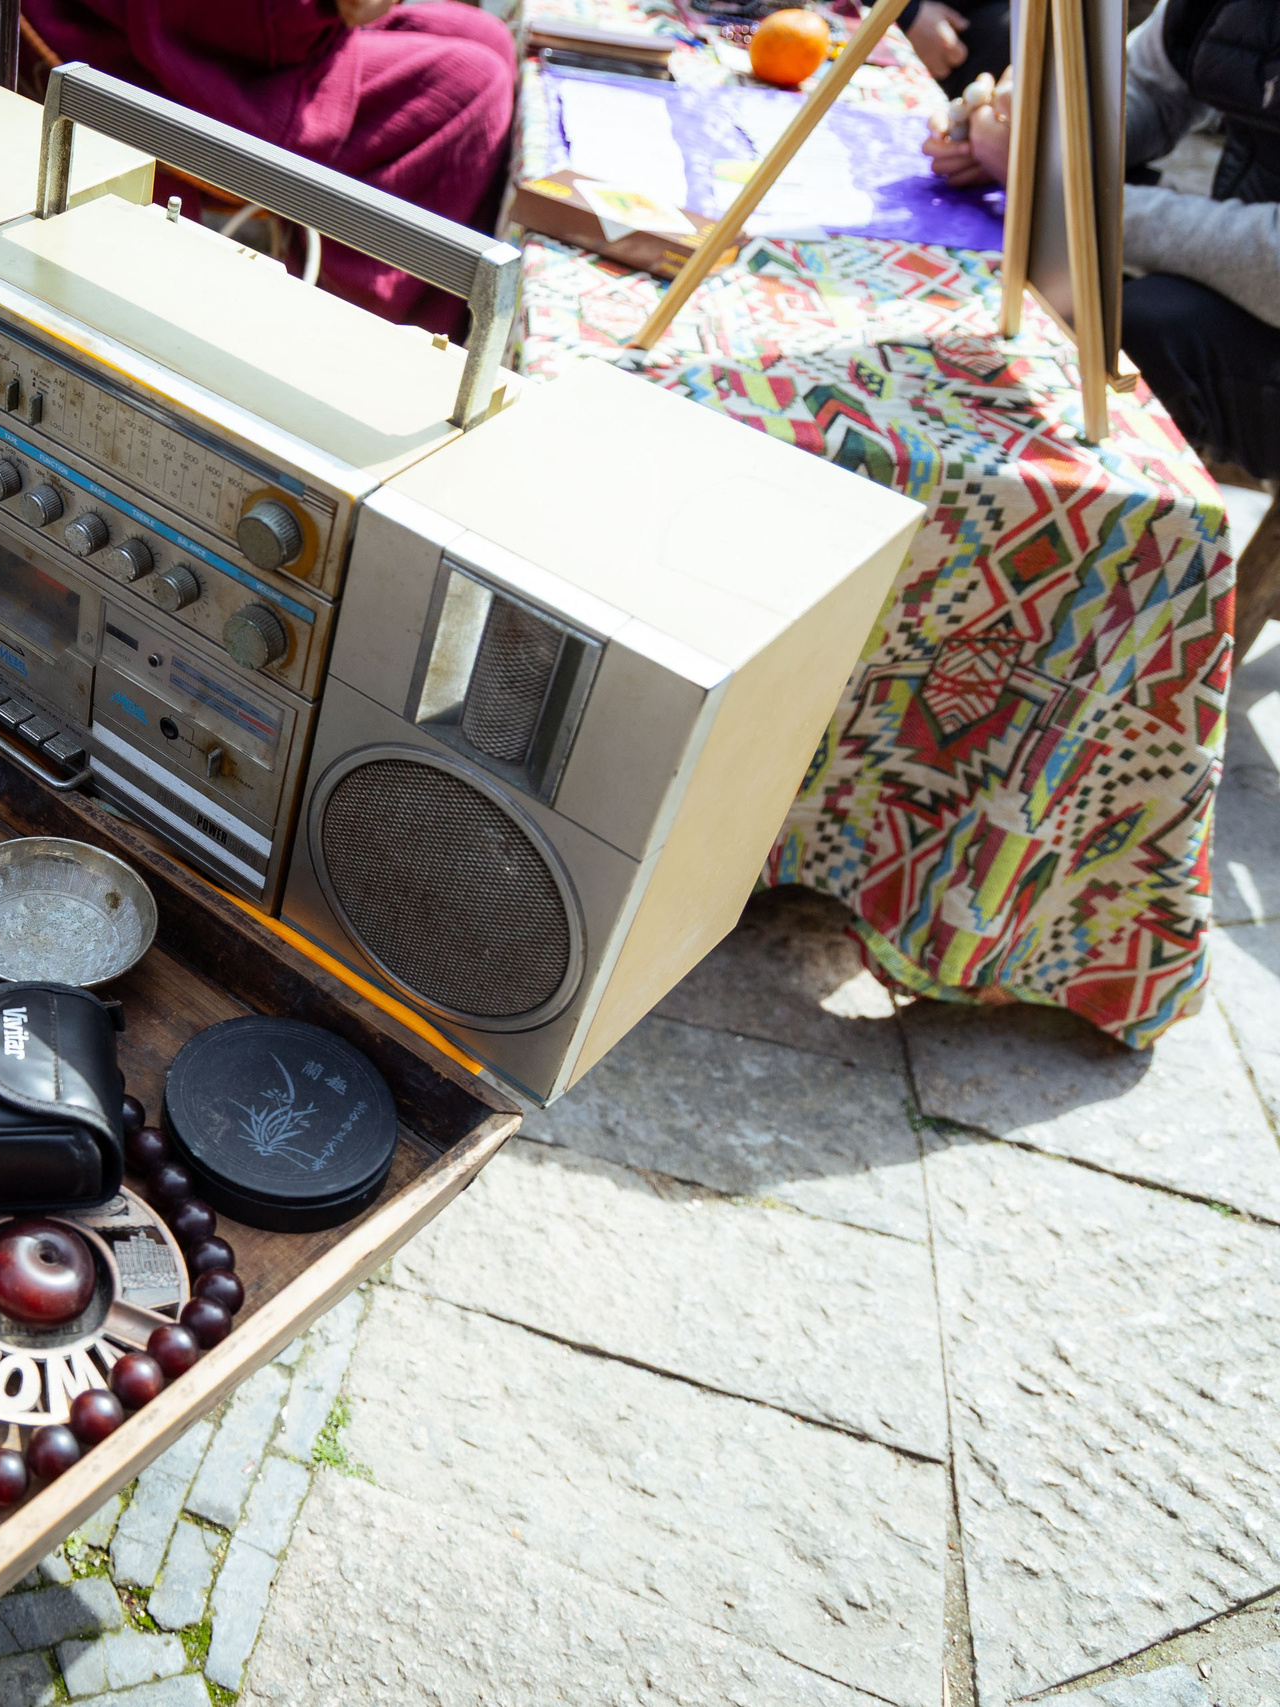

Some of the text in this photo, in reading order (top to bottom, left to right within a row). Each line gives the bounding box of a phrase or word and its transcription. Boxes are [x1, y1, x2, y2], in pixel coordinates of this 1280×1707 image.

[50, 421, 62, 432] LOG
[54, 378, 66, 388] AM
[73, 389, 86, 401] 540
[97, 402, 110, 414] 600
[124, 418, 137, 430] 700
[138, 426, 152, 438] 800
[161, 439, 177, 453] 1000
[183, 452, 199, 465] 1200
[205, 463, 221, 478] 1400
[4, 432, 18, 446] TAPE
[16, 457, 30, 469] METAL
[39, 454, 69, 475] FUNCTION
[34, 468, 46, 479] TAPE
[89, 484, 106, 499] BASS
[132, 509, 155, 528] TREBLE
[177, 536, 207, 558] BALANCE
[256, 582, 282, 601] VOLUME
[196, 813, 228, 845] POWER
[2, 1006, 30, 1060] Vivitar
